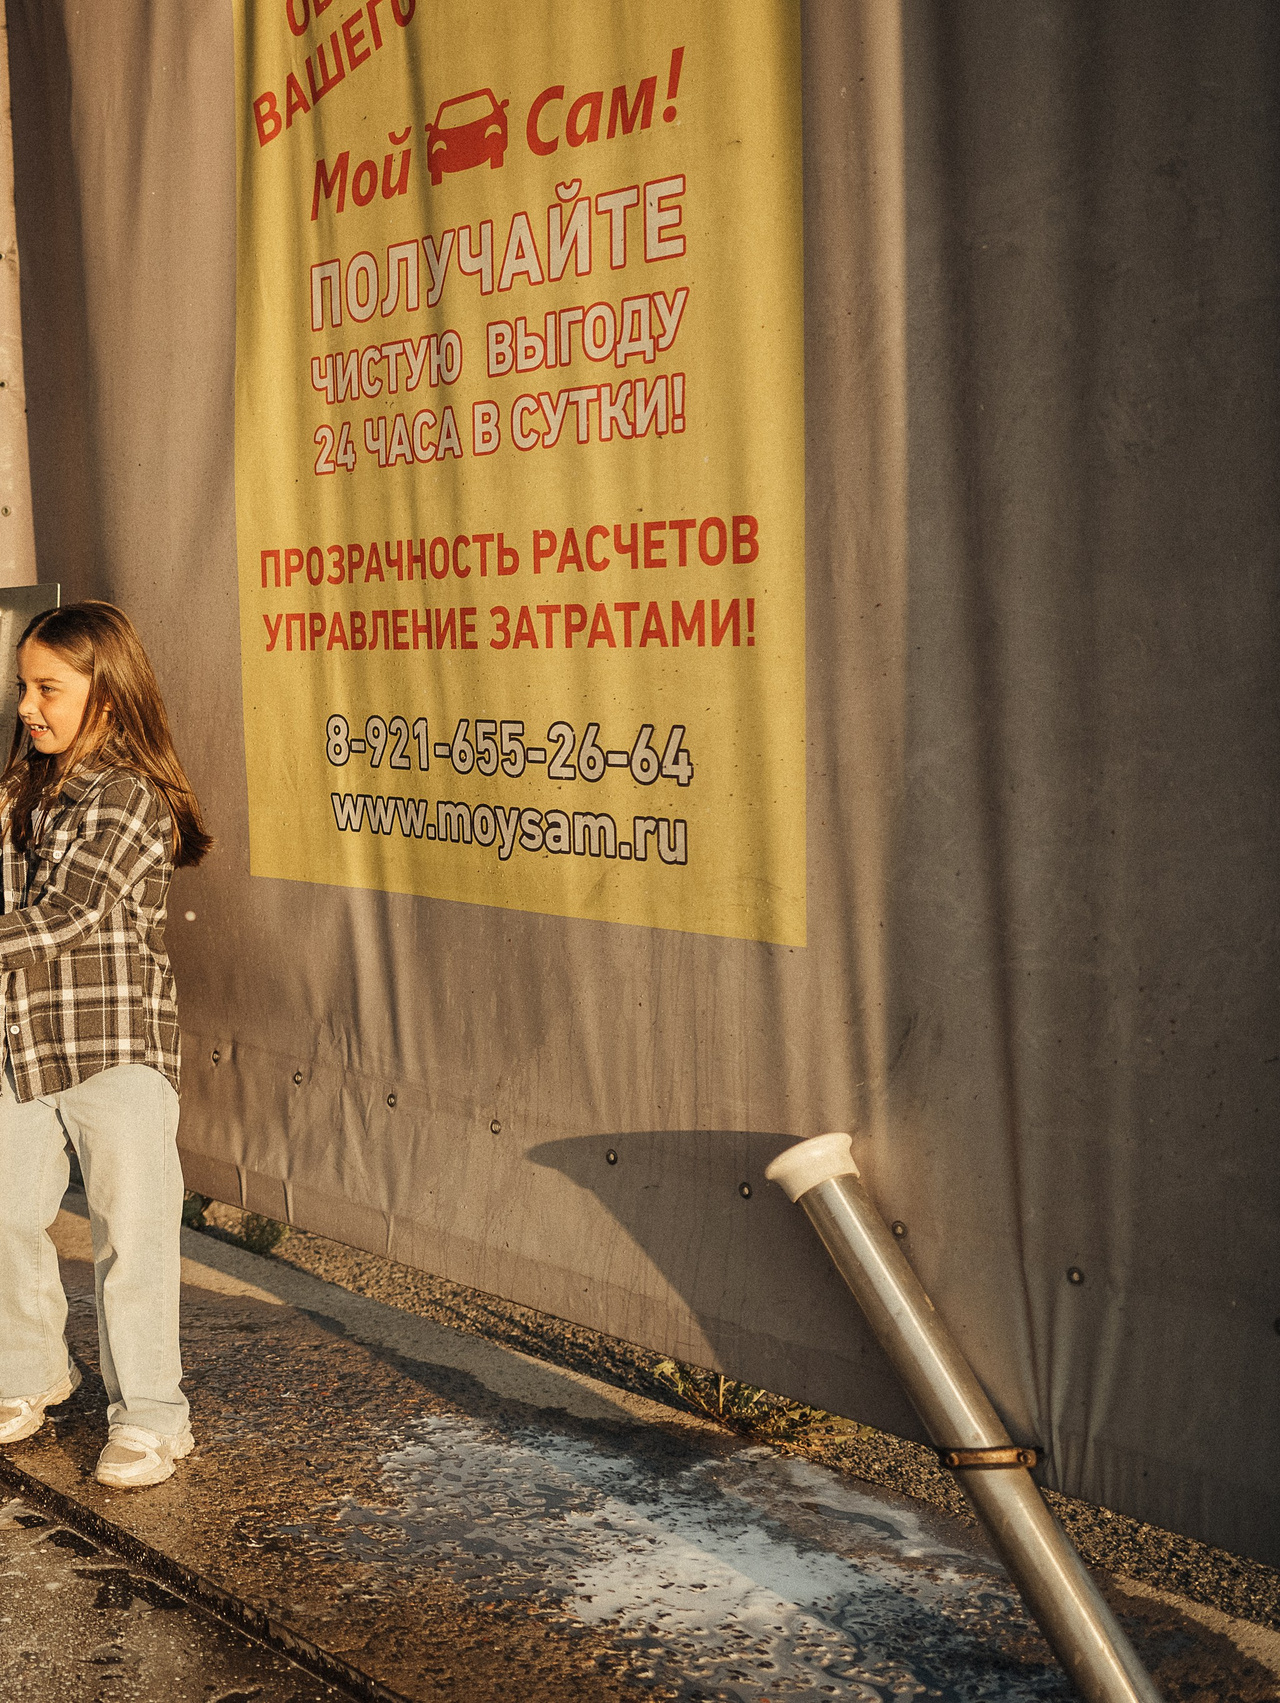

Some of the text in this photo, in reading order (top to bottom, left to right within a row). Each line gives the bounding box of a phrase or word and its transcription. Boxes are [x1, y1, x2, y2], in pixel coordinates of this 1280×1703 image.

[310, 46, 686, 221] Мой Сам!
[310, 174, 687, 332] ПОЛУЧАЙТЕ
[310, 286, 690, 405] ЧИСТУЮ ВЫГОДУ
[313, 372, 687, 476] 24 ЧАСА В СУТКИ!
[259, 514, 761, 589] ПРОЗРАЧНОСТЬ РАСЧЕТОВ
[262, 597, 757, 653] УПРАВЛЕНИЕ ЗАТРАТАМИ!
[325, 714, 694, 786] 8-921-655-26-64
[331, 792, 688, 865] www.moysam.ru
